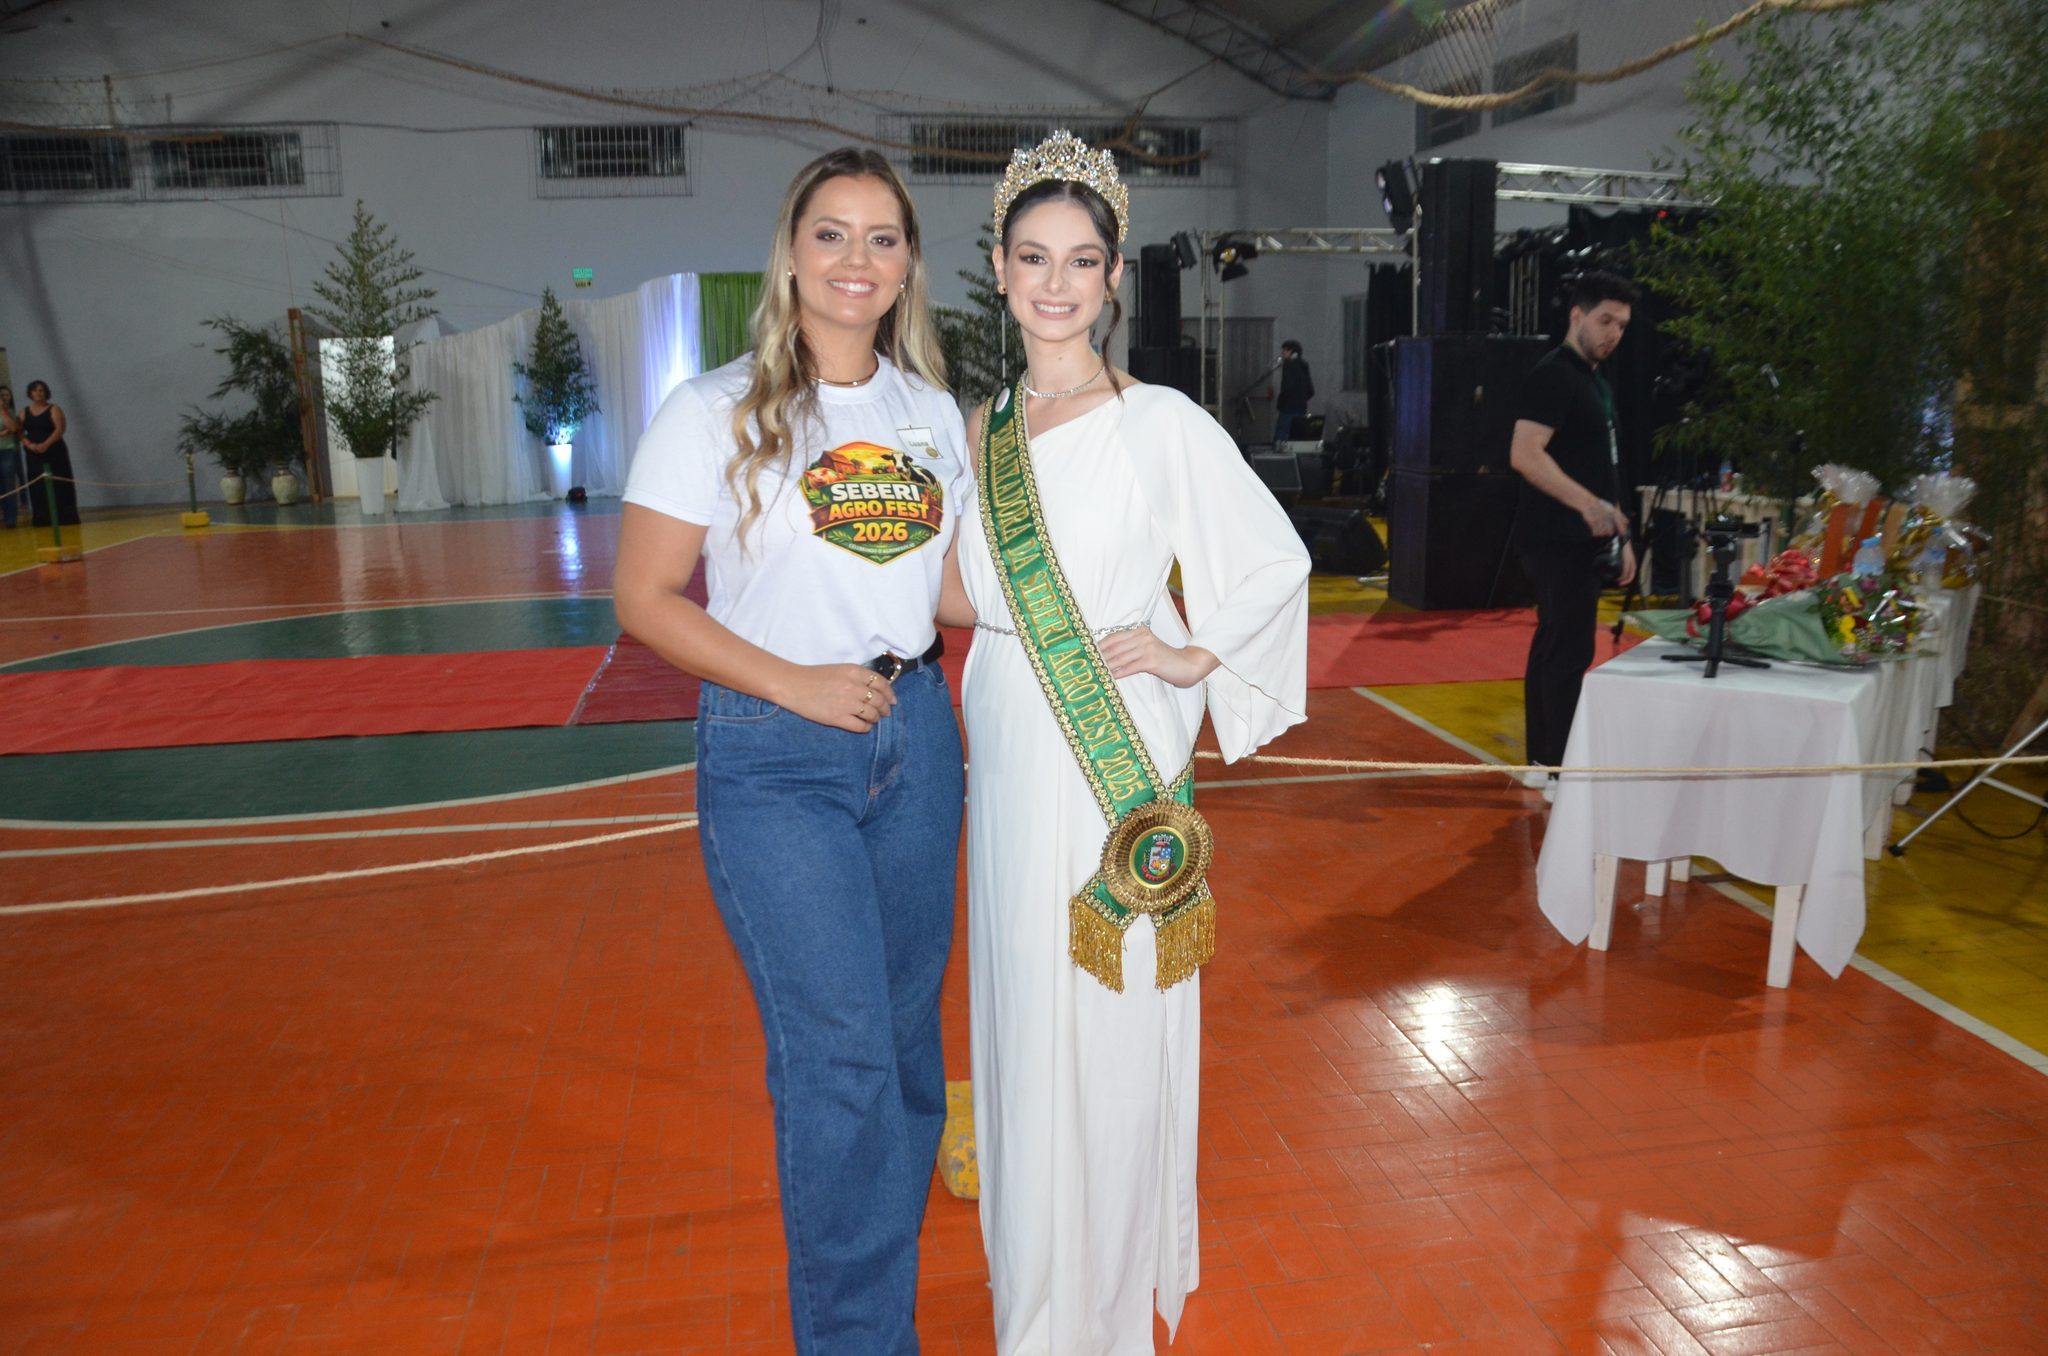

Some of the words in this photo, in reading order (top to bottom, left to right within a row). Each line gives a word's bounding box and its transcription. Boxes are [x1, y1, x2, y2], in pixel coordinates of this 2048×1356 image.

[828, 500, 883, 521] AGRO
[886, 500, 929, 519] FEST
[830, 483, 921, 502] SEBERI
[853, 522, 909, 542] 2026
[1006, 537, 1041, 574] DA
[1018, 570, 1075, 649] SEBERI
[1048, 648, 1098, 702] AGRO
[1071, 696, 1122, 751] FEST
[1096, 748, 1147, 801] 2025
